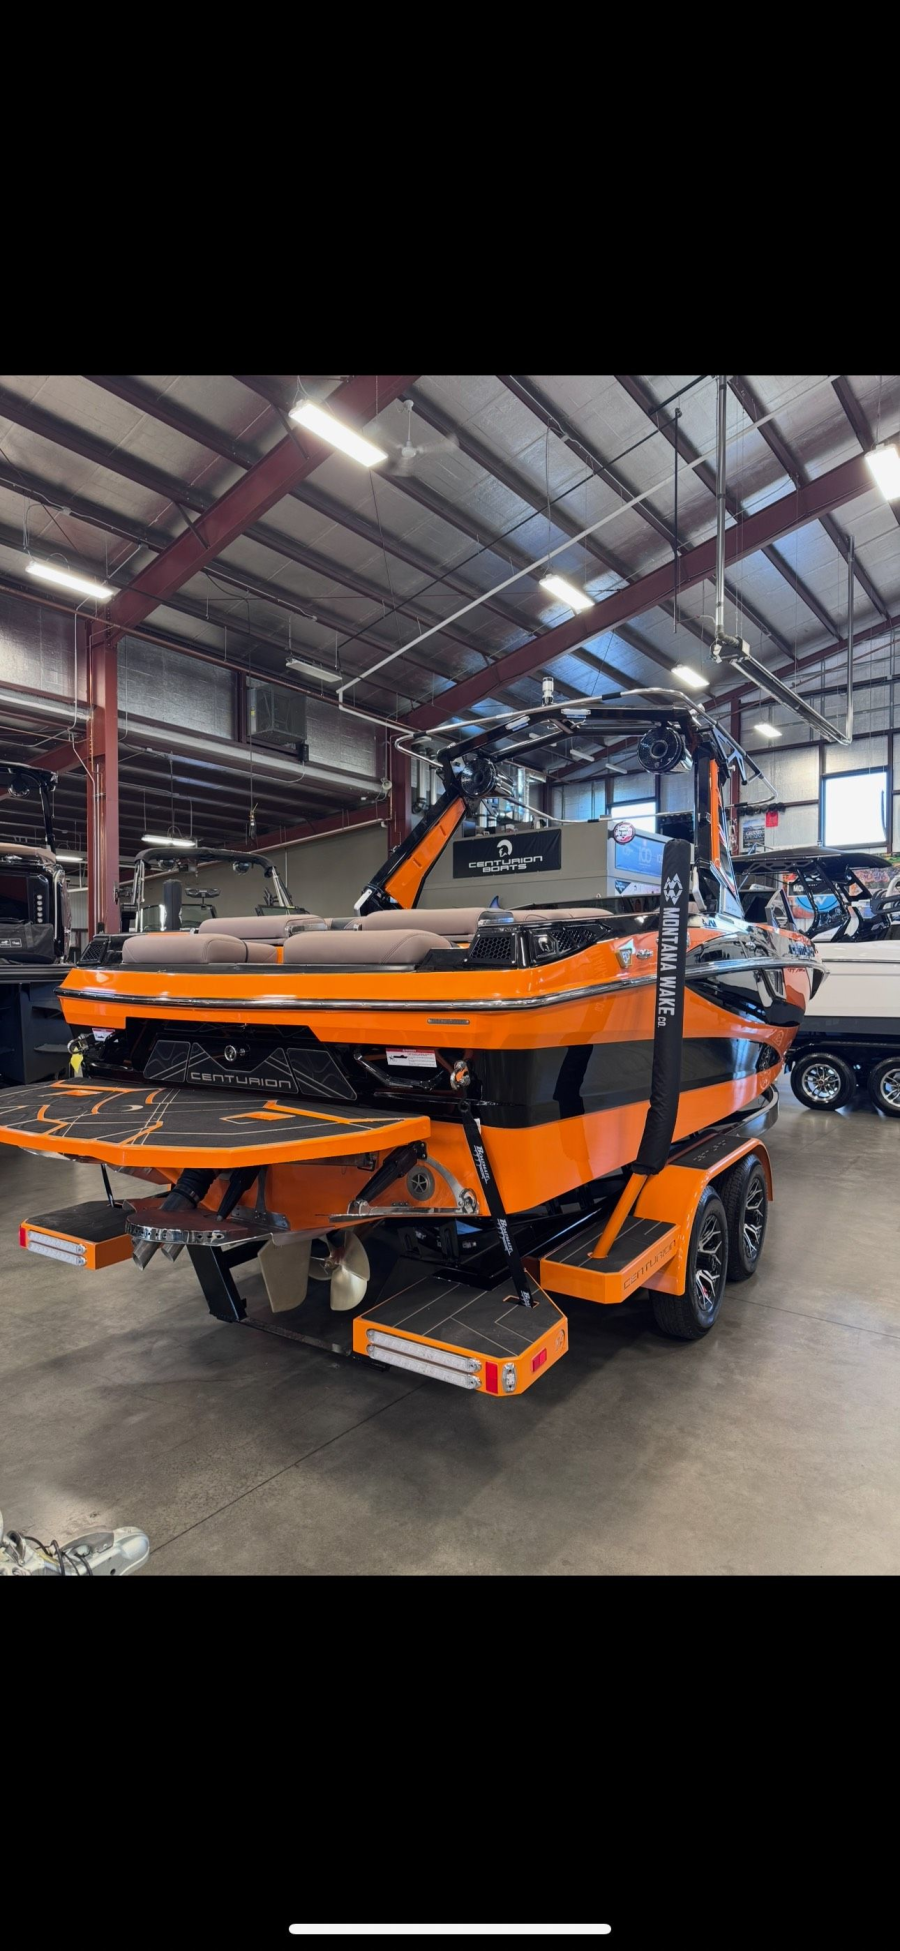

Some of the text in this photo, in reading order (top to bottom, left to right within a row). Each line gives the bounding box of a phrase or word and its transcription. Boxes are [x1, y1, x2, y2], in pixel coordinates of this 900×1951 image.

[468, 855, 543, 868] CENTURION
[482, 863, 527, 873] BOATS
[659, 907, 681, 972] MONTANA
[658, 976, 677, 1016] WAKE
[190, 1072, 292, 1088] CENTURION
[623, 1239, 676, 1290] CENTURION
